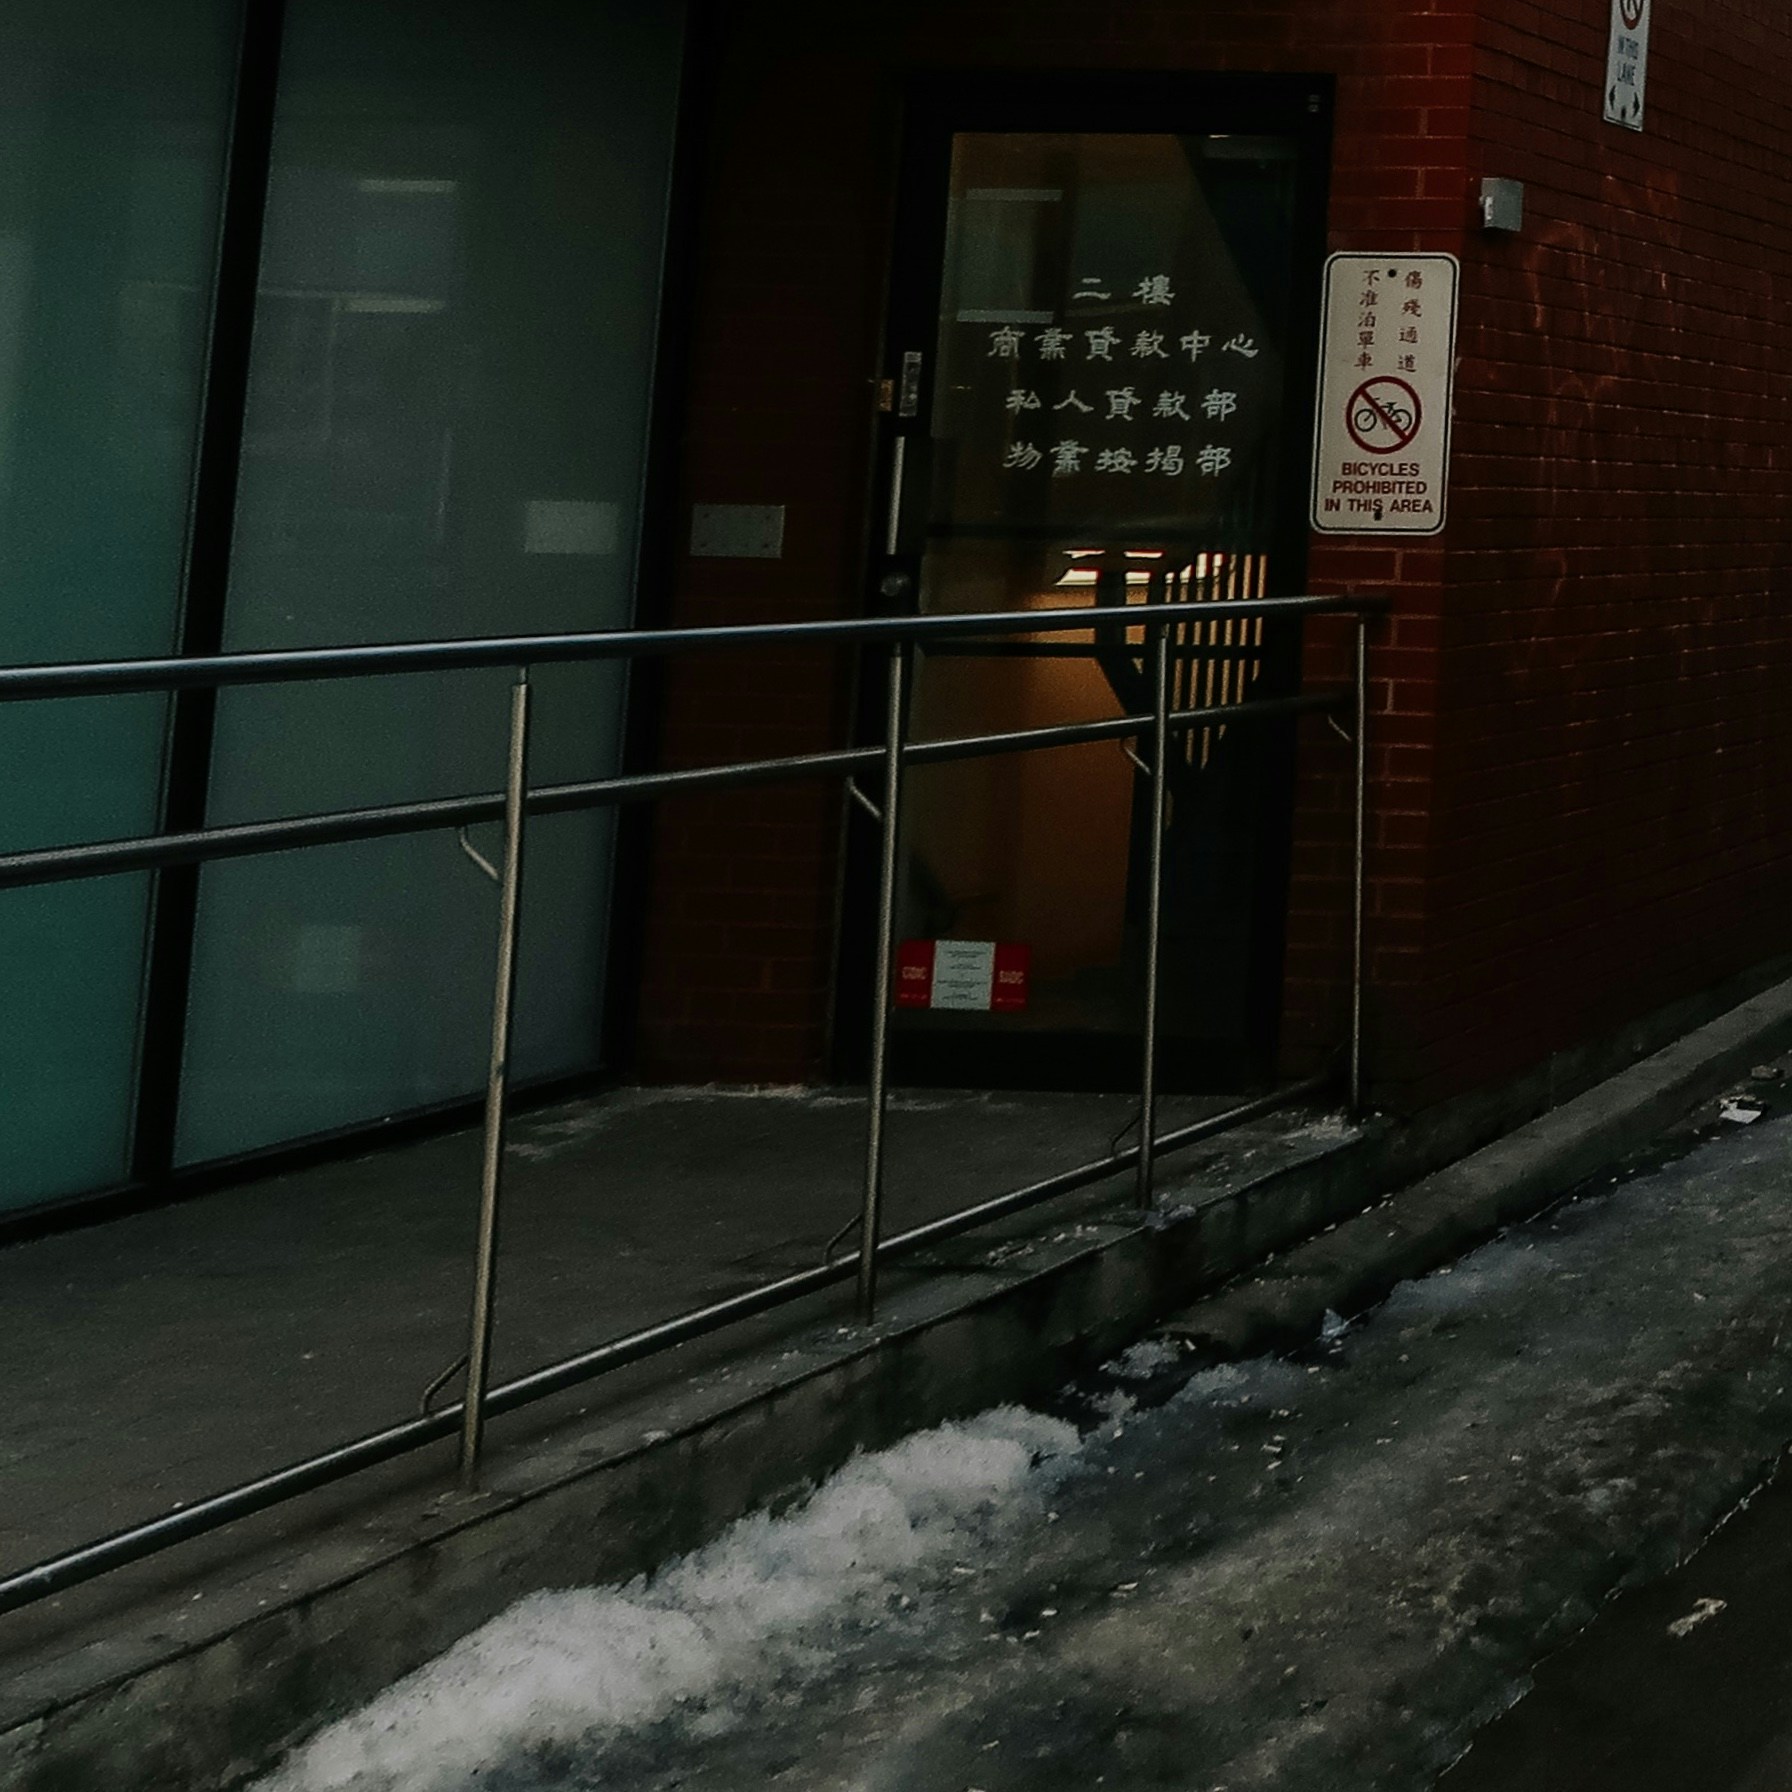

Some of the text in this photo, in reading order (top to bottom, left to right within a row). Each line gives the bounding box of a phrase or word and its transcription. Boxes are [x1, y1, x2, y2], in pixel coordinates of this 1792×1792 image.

[1072, 274, 1176, 306] 二樓
[1354, 269, 1380, 371] 不准泊單車
[1396, 270, 1423, 373] 傷殘通道
[1342, 462, 1419, 477] BICYCLES
[1333, 480, 1427, 495] PROHIBITED
[1325, 498, 1433, 514] IN THIS AREA
